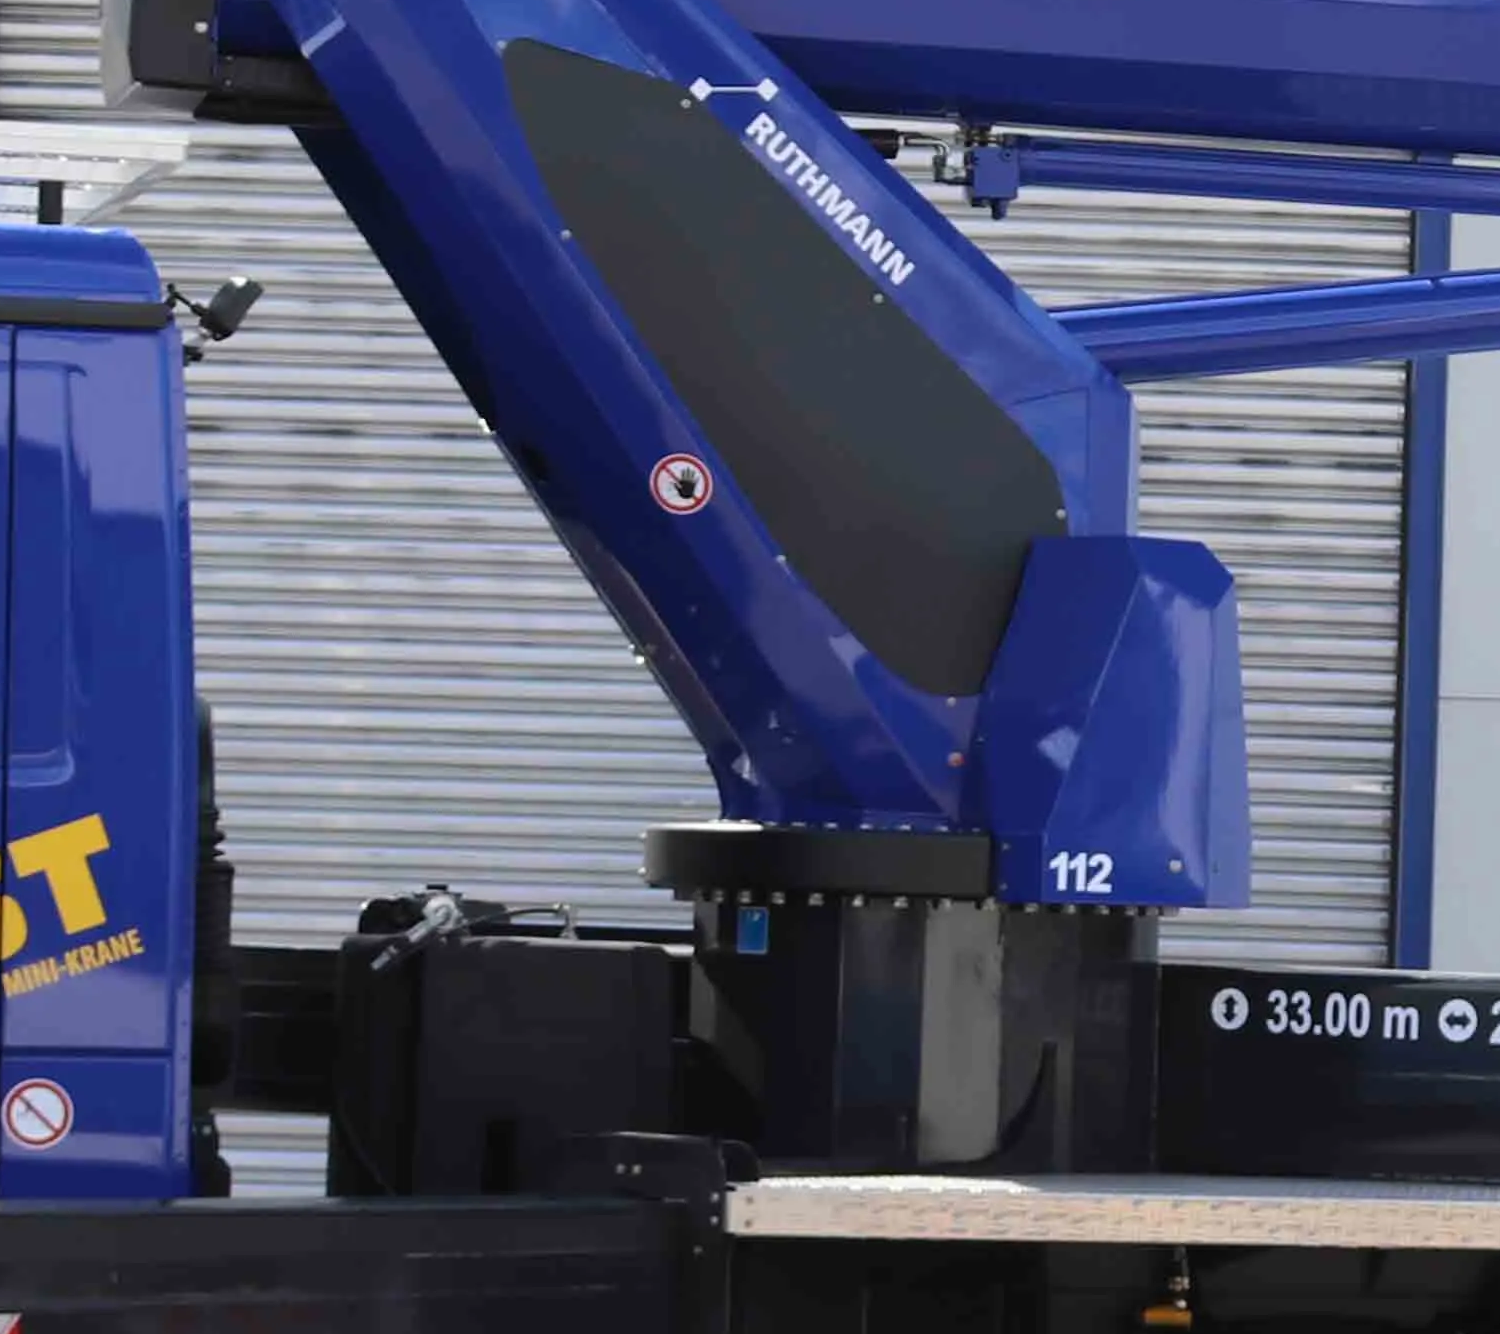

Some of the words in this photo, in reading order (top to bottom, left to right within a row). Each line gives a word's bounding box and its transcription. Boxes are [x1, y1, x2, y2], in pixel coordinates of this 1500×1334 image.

[744, 112, 915, 285] RUTHMANN
[1049, 851, 1113, 893] 112
[1, 928, 145, 998] MINI-KRANE
[1265, 989, 1371, 1038] 33.00
[1383, 1005, 1419, 1041] m
